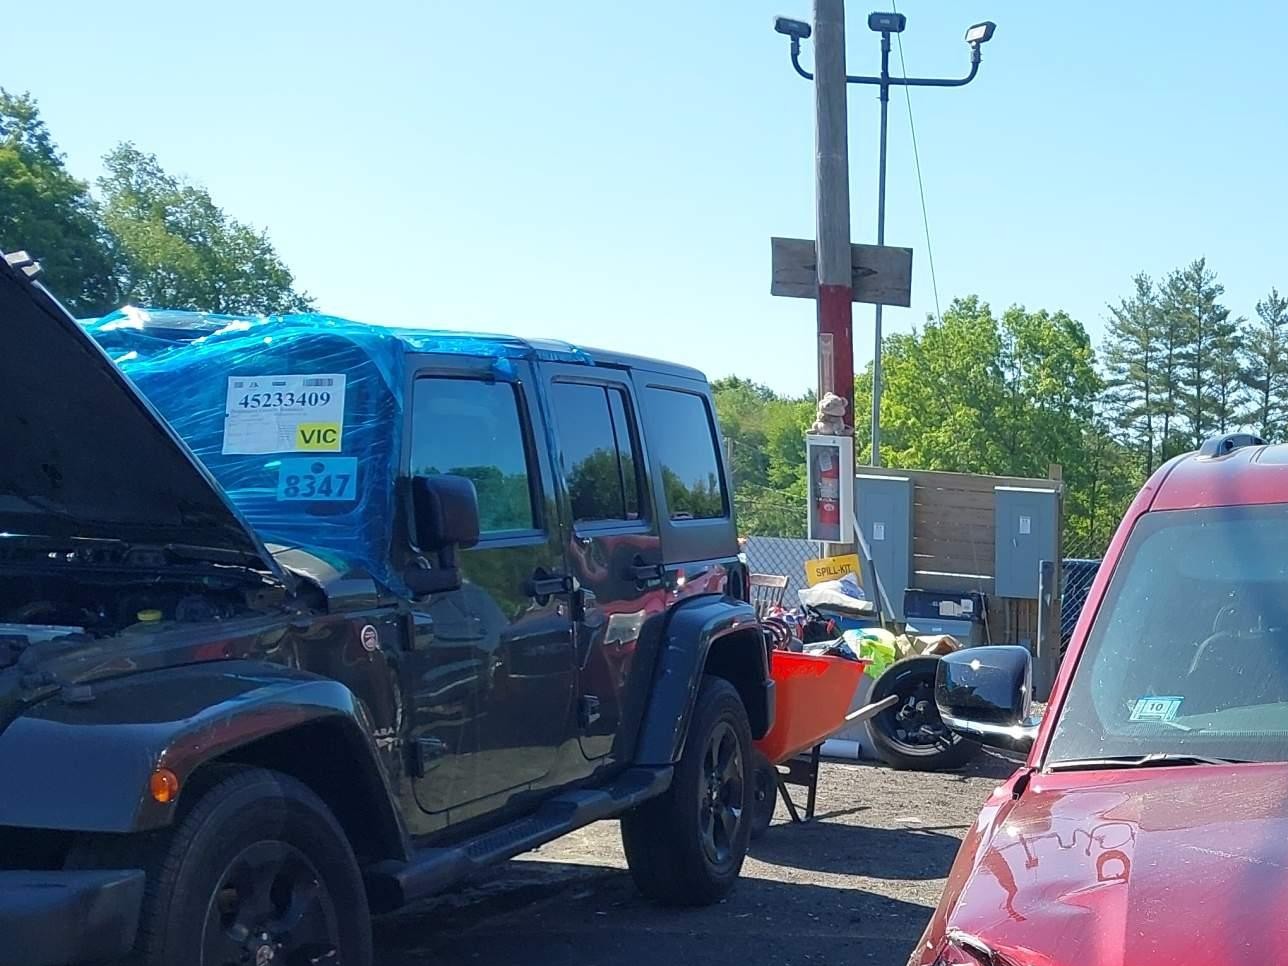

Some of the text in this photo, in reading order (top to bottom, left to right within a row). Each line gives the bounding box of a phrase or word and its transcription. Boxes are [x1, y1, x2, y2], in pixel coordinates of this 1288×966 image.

[238, 391, 331, 408] 45233409
[299, 428, 338, 444] VIC
[283, 474, 352, 498] 8347
[815, 563, 852, 577] SPILL-KIT
[1150, 703, 1164, 712] 10
